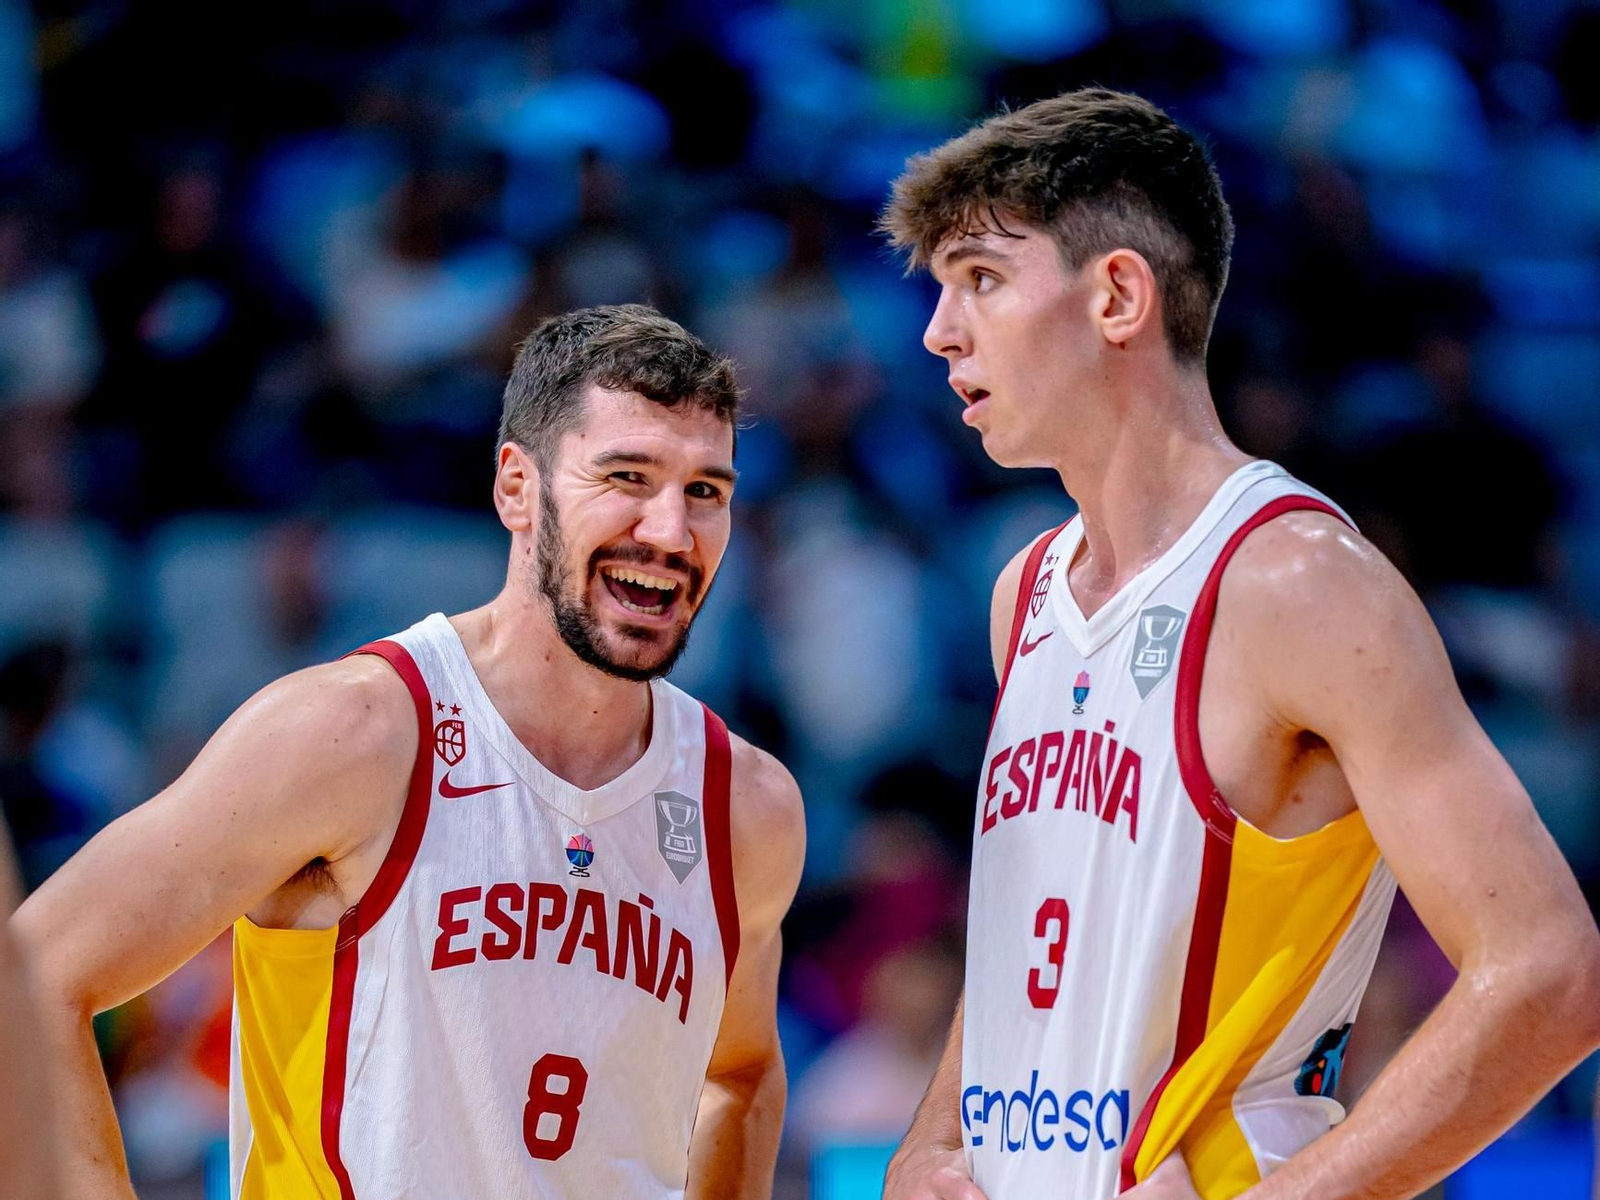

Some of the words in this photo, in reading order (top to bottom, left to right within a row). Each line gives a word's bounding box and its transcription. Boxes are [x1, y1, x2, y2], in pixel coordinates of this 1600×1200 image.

[981, 719, 1143, 845] ESPAÑA
[431, 881, 694, 1025] ESPAÑA
[1027, 897, 1070, 1010] 3
[522, 1052, 589, 1161] 8
[961, 1069, 1131, 1153] endesa
